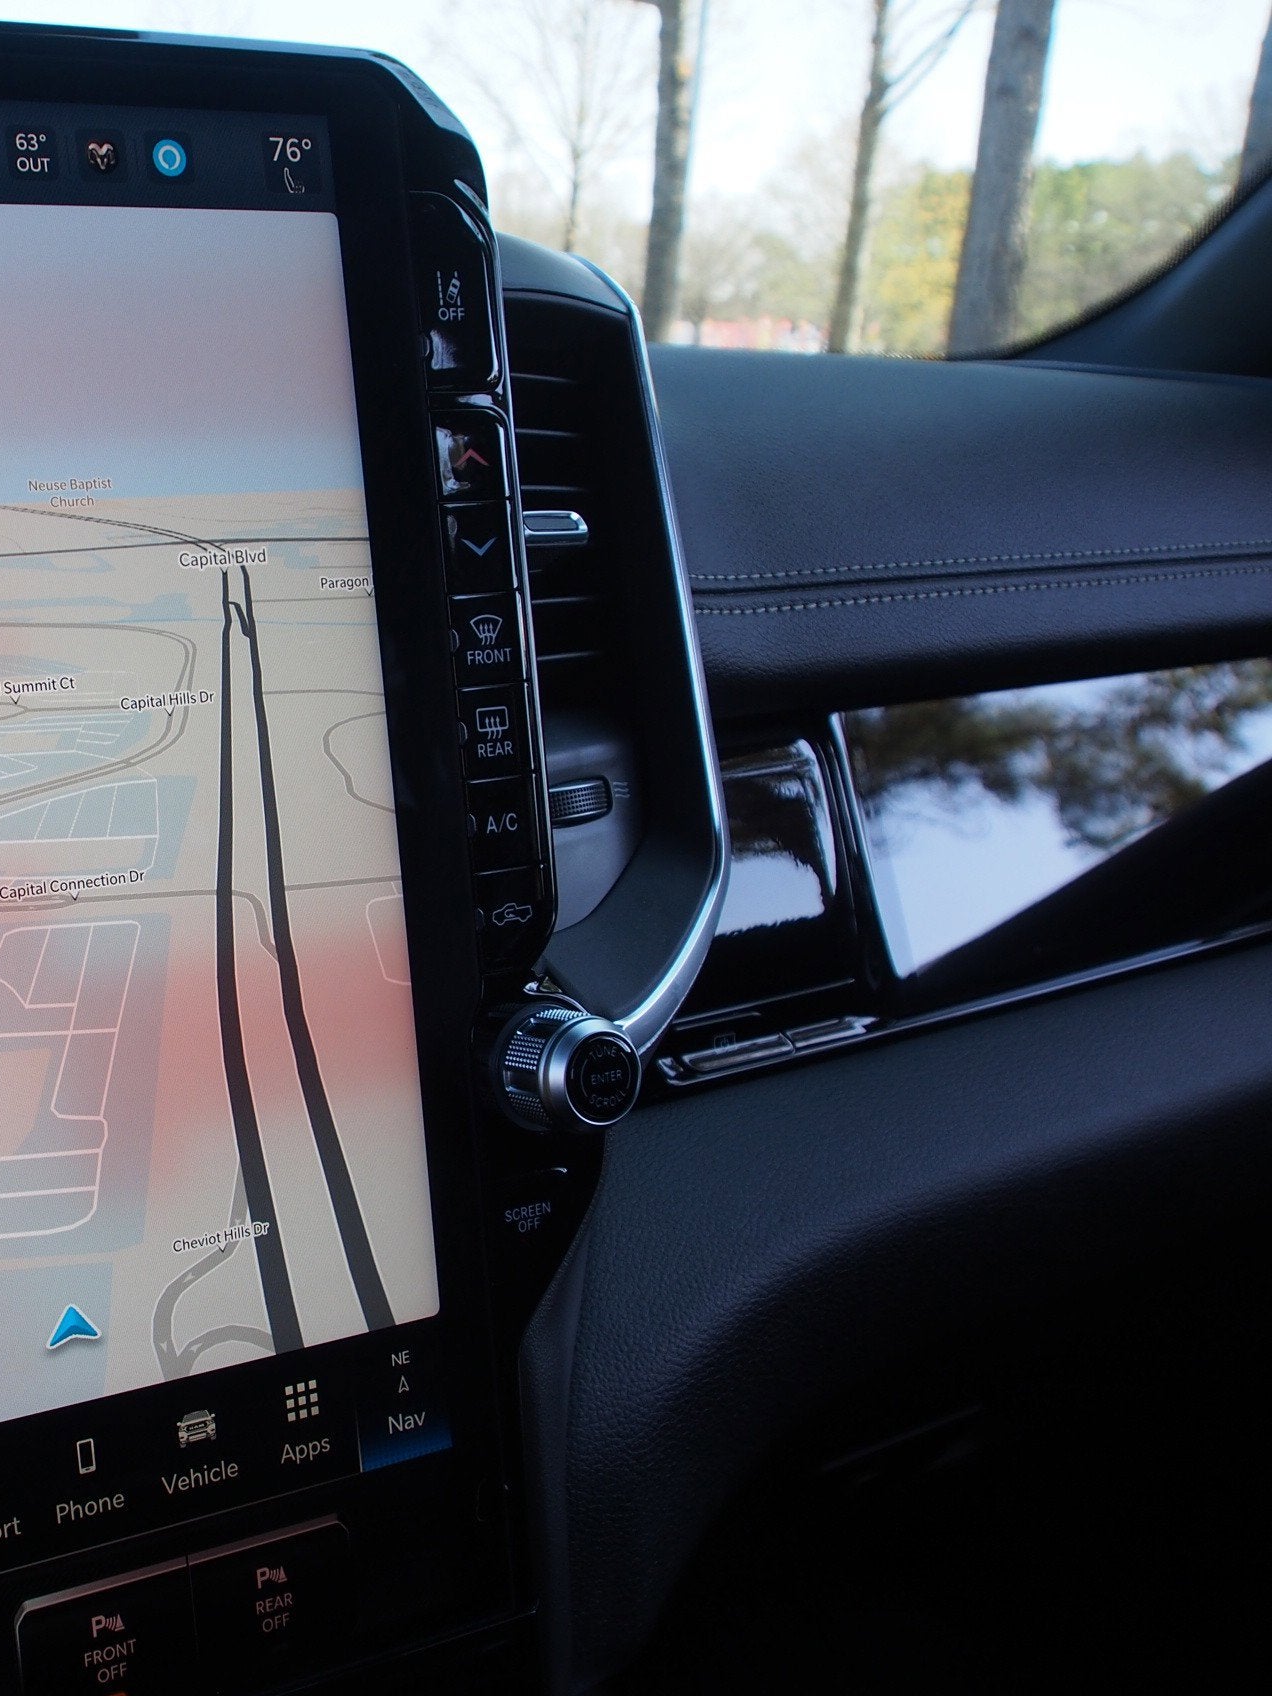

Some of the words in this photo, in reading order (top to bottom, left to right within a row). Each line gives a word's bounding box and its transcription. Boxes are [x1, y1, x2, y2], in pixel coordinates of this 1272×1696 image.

[15, 133, 47, 152] 63°
[269, 136, 312, 163] 76°
[16, 156, 51, 174] OUT
[438, 307, 466, 322] OFF
[28, 479, 67, 493] Neuse
[70, 477, 113, 495] Baptist
[50, 494, 95, 509] Church
[179, 550, 231, 569] Capital
[234, 547, 267, 566] Blvd
[320, 576, 370, 591] Paragon
[466, 647, 513, 666] FRONT
[3, 678, 57, 695] Summit
[59, 676, 75, 690] Ct
[120, 694, 166, 714] Capital
[168, 691, 197, 707] Hills
[199, 690, 215, 704] Dr
[477, 740, 514, 759] REAR
[486, 812, 519, 834] A/C
[49, 873, 127, 895] Connection
[129, 869, 145, 885] Dr
[590, 1069, 624, 1086] ENTER
[504, 1201, 552, 1223] SCREEN
[518, 1217, 542, 1234] OFF
[172, 1233, 222, 1253] Cheviot
[223, 1226, 251, 1243] Hills
[253, 1222, 269, 1237] Dr
[391, 1350, 411, 1367] NE
[387, 1411, 427, 1435] Nav
[280, 1435, 331, 1465] Apps
[161, 1459, 239, 1495] Vehicle
[55, 1491, 125, 1525] Phone
[255, 1592, 293, 1615] REAR
[262, 1612, 290, 1633] OFF
[83, 1638, 137, 1668] FRONT
[97, 1662, 127, 1683] OFF
